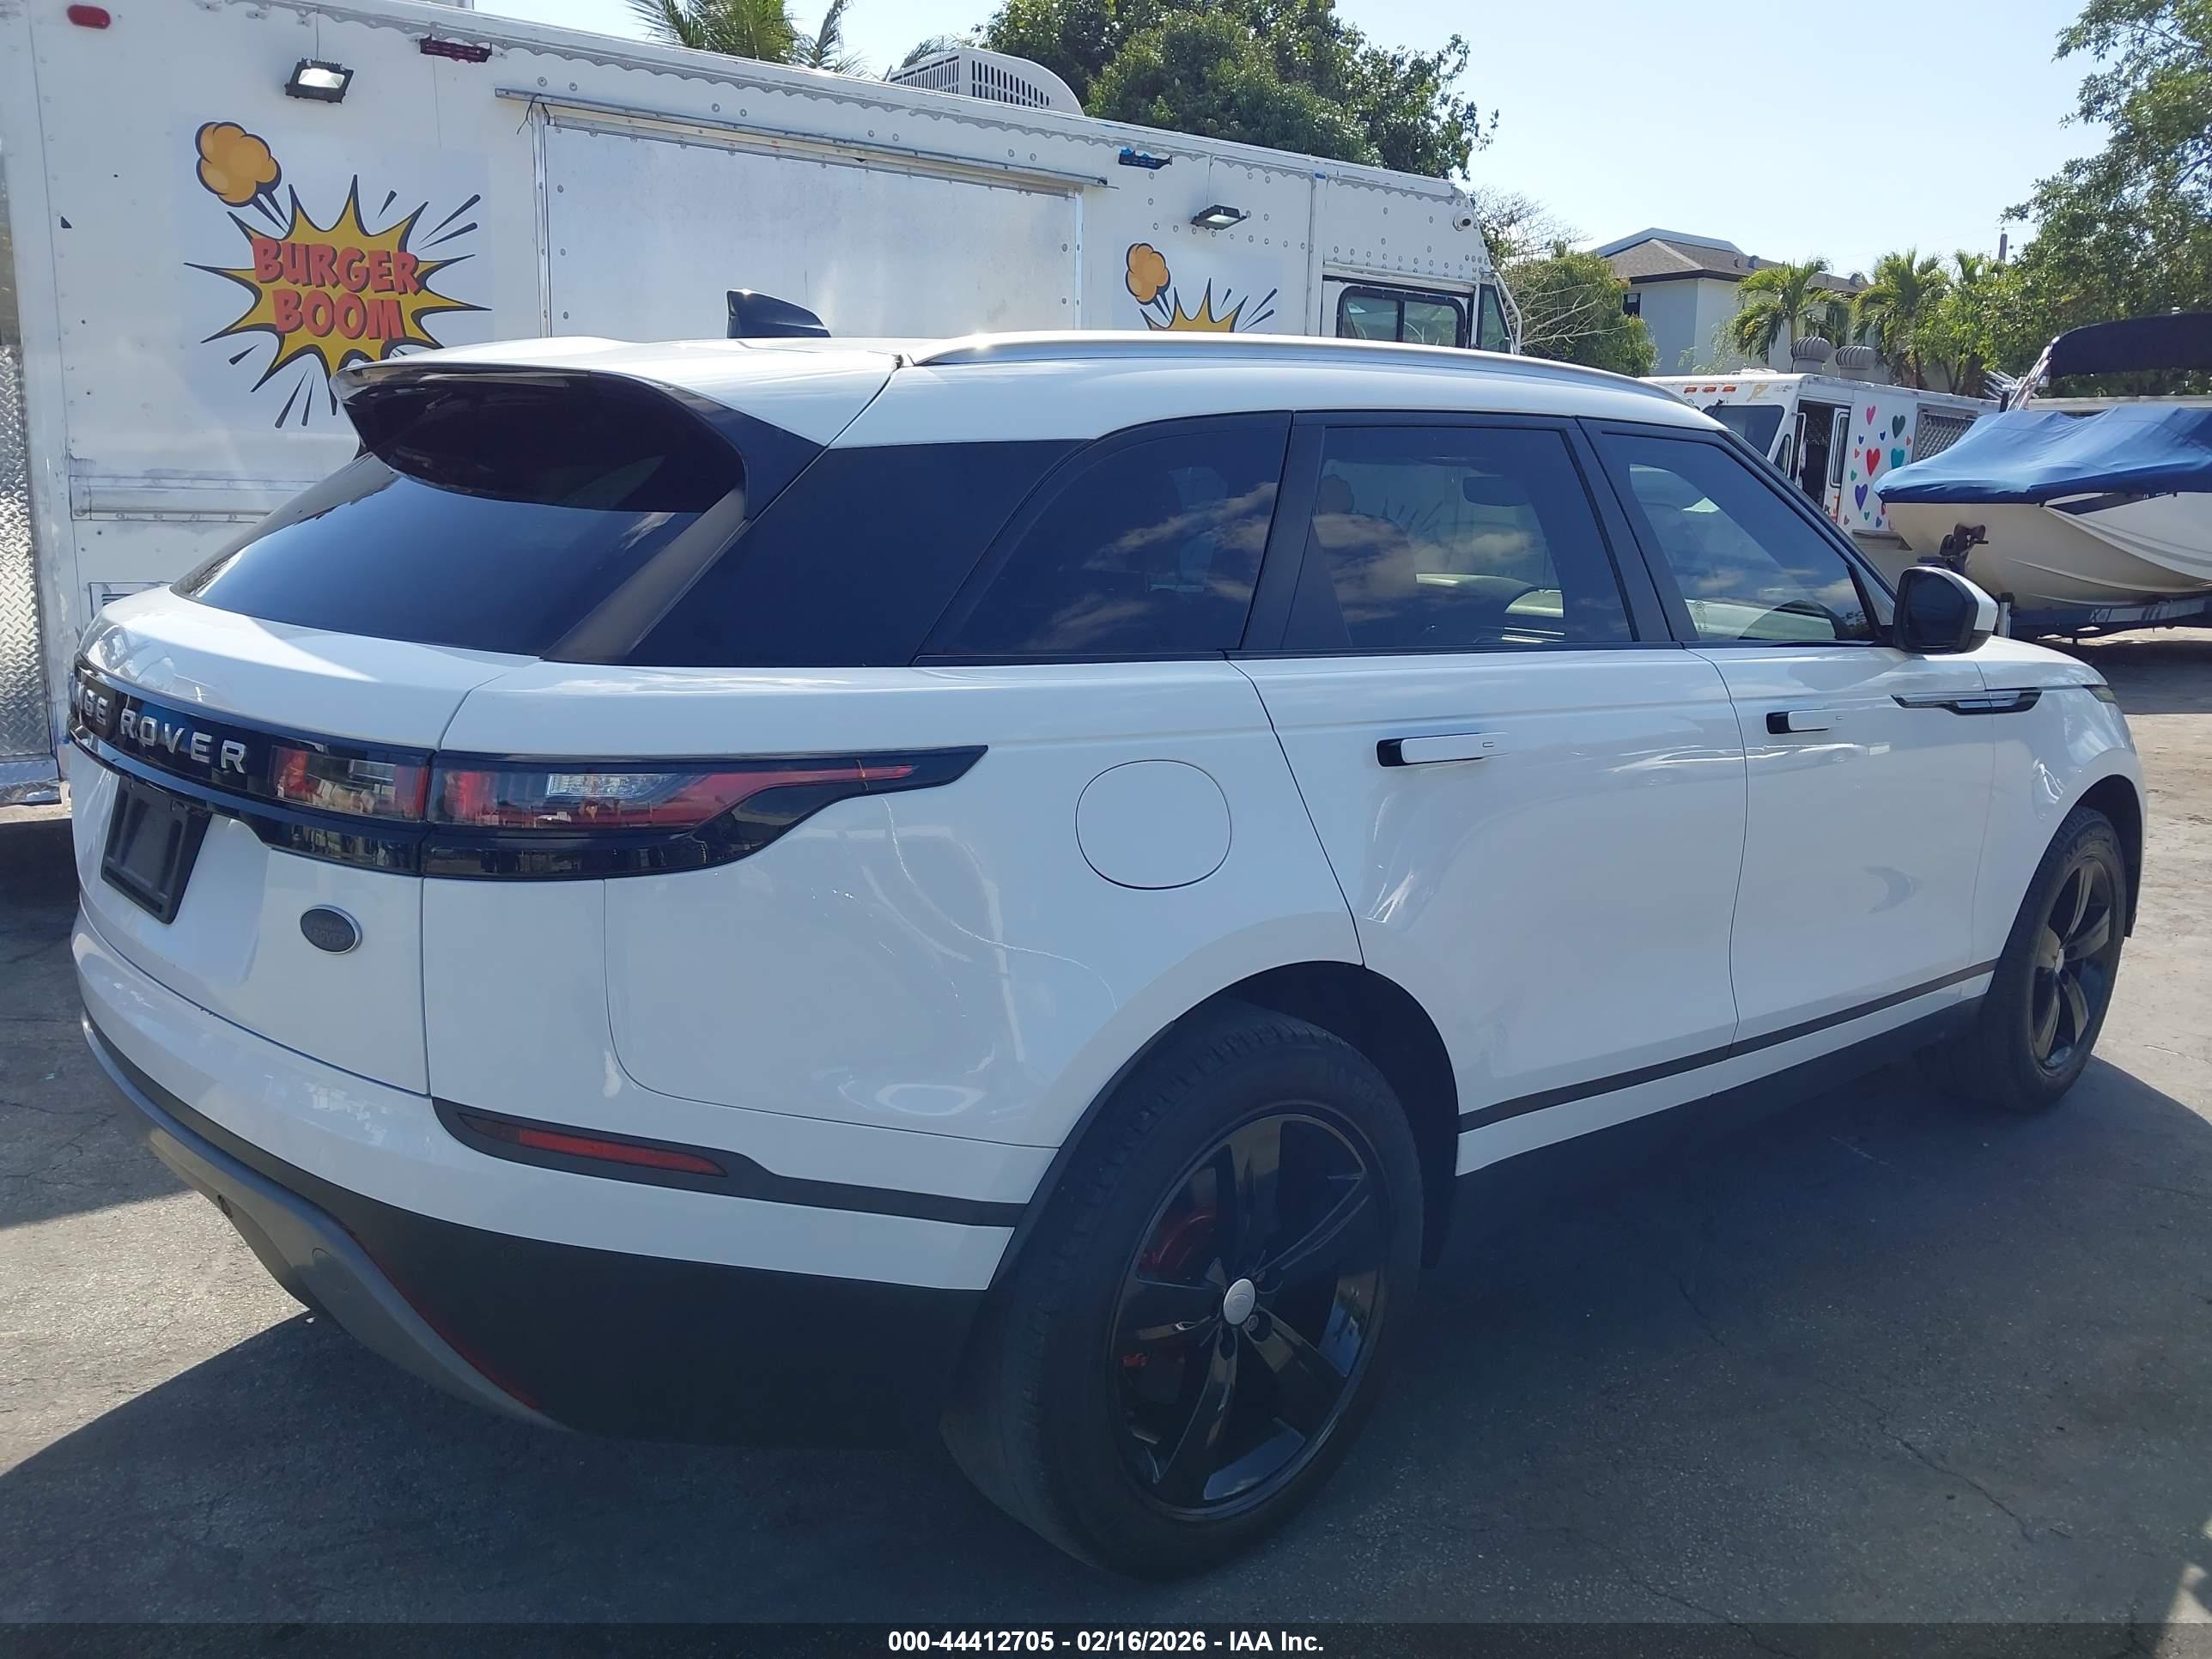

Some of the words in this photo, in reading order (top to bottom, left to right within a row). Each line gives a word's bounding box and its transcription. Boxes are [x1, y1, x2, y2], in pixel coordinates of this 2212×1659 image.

[252, 238, 420, 296] BURGER
[272, 289, 407, 341] BOOM
[119, 708, 246, 774] ROVER
